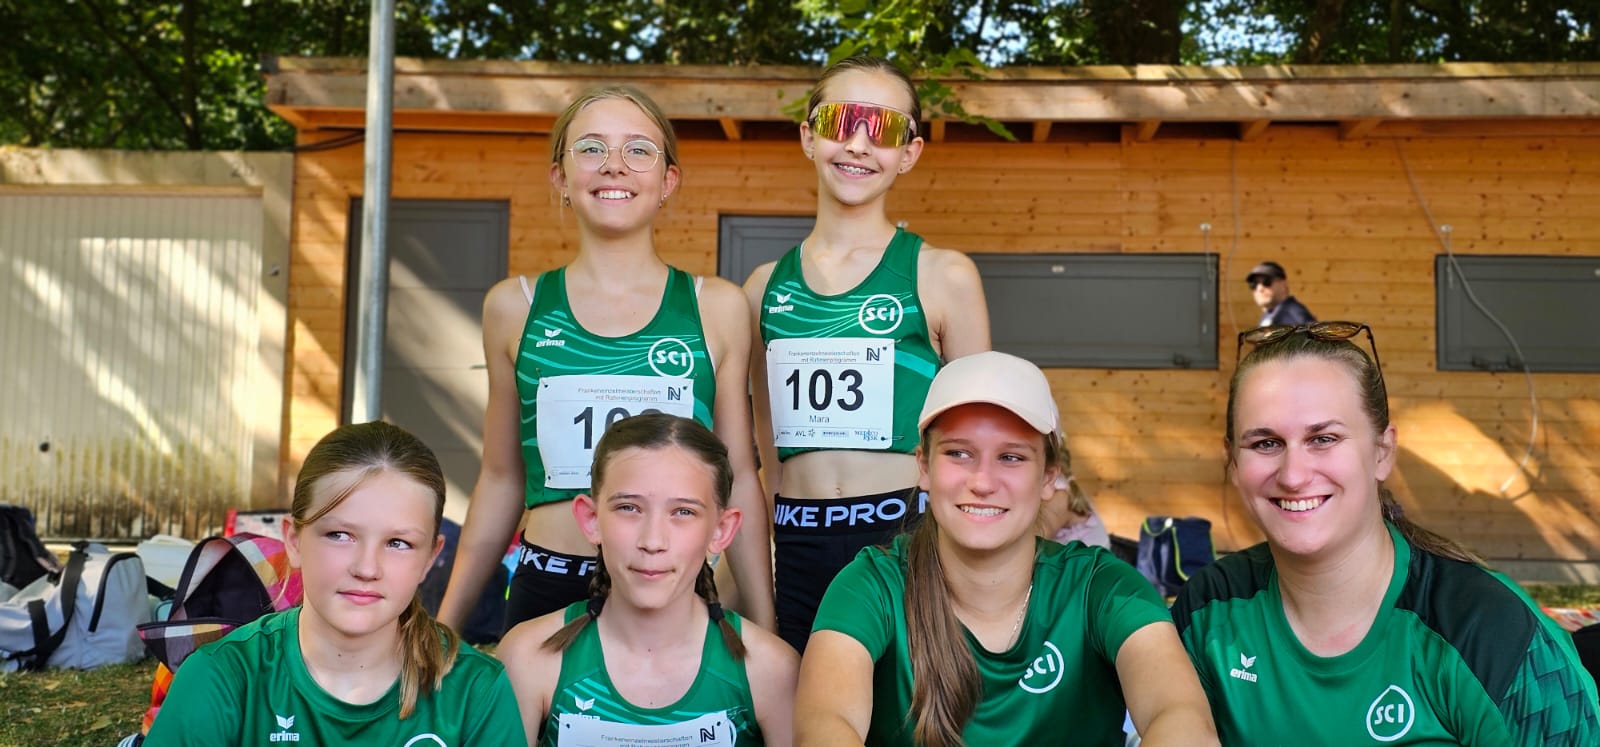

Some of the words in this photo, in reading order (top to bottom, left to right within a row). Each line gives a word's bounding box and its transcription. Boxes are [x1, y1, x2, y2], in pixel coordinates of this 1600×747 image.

[865, 307, 895, 321] SCI
[535, 338, 565, 348] erima
[656, 350, 687, 367] SCI
[785, 368, 864, 411] 103
[809, 415, 830, 423] Mara
[825, 498, 906, 527] PRO
[1230, 668, 1258, 683] erima
[1374, 703, 1405, 725] SCI
[269, 730, 300, 742] erima
